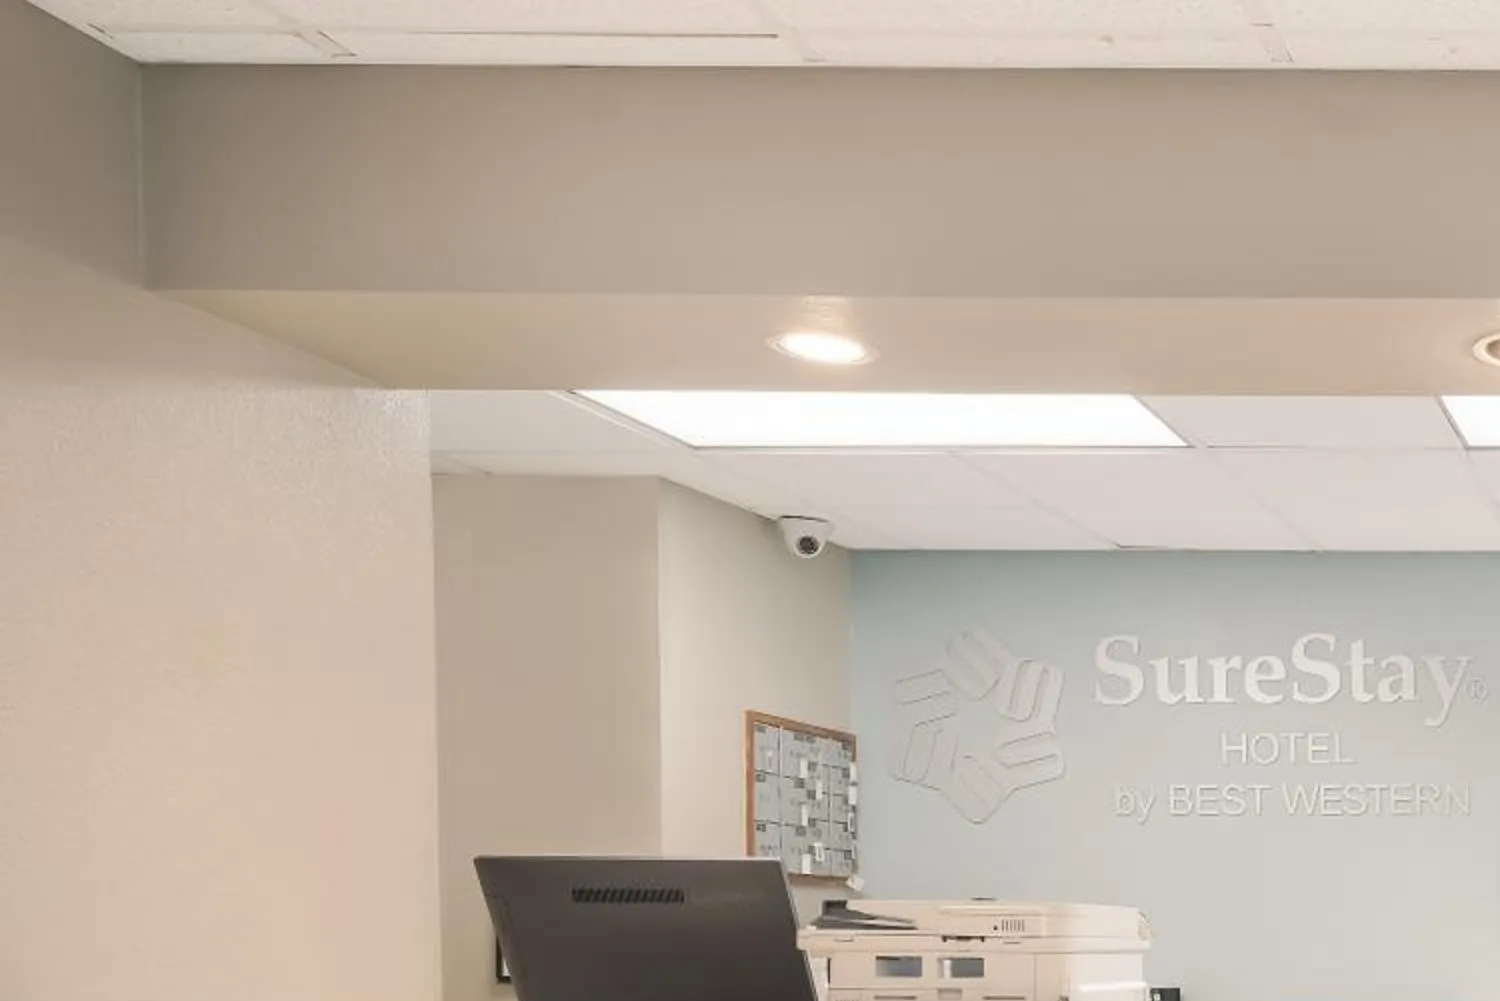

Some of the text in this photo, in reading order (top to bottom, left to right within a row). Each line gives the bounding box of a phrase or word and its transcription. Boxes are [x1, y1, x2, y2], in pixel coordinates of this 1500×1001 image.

[1220, 732, 1356, 767] HOTEL
[1115, 785, 1473, 824] by BEST WESTERN
